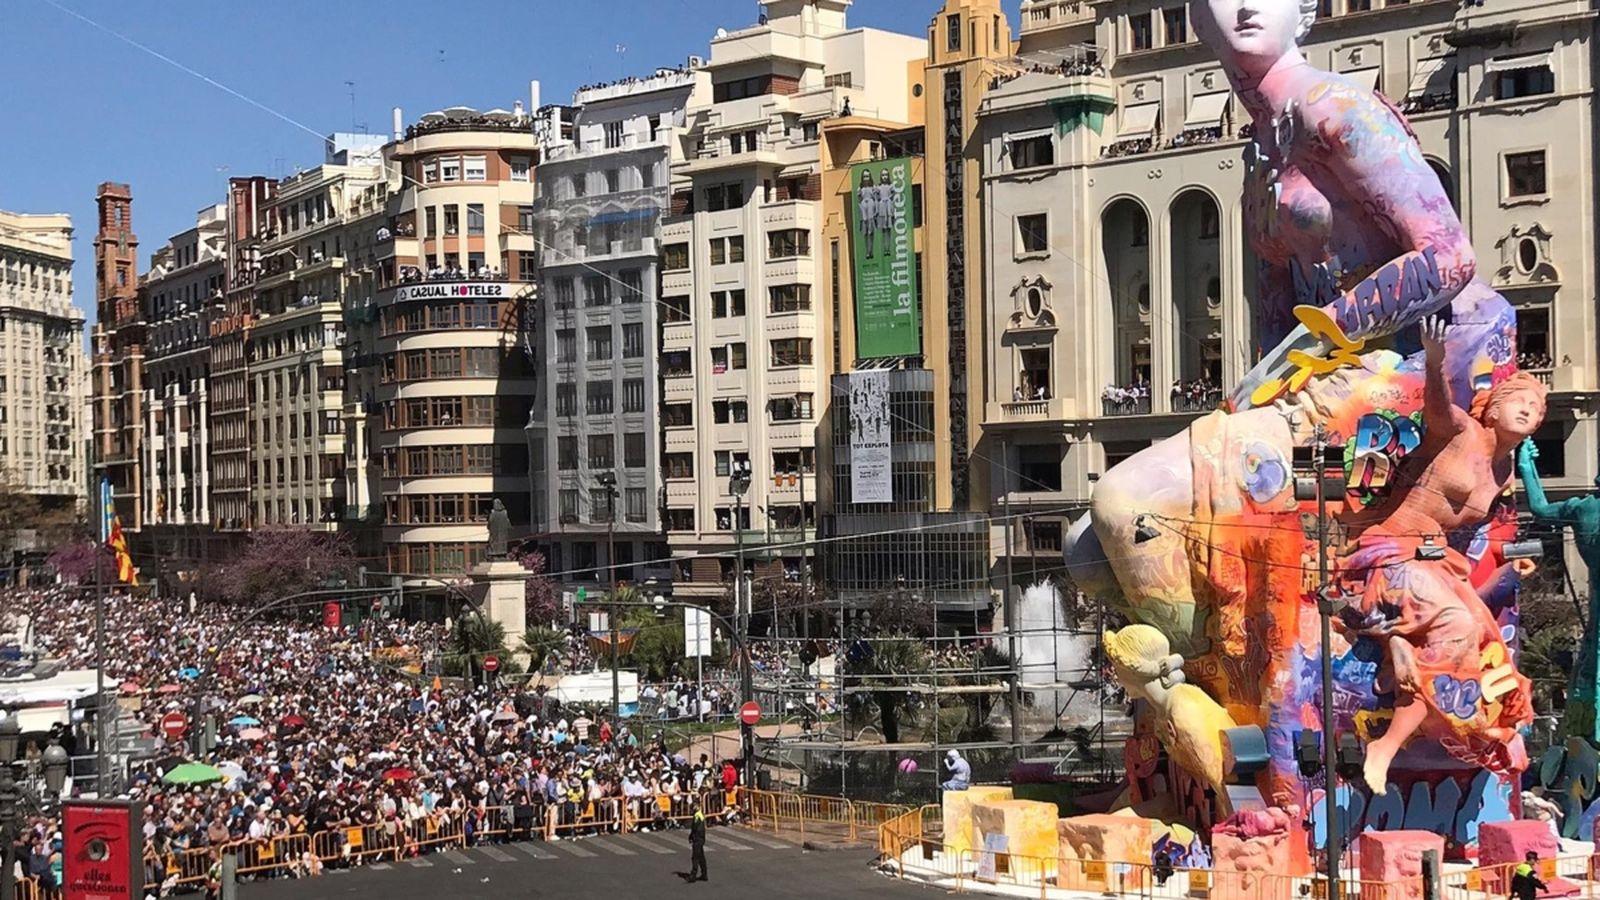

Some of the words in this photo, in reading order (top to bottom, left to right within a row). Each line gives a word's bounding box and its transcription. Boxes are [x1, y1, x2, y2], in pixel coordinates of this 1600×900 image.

[891, 163, 910, 287] filmoteca
[410, 286, 448, 298] CASUAL
[451, 285, 502, 296] HOTELES
[893, 292, 912, 317] la
